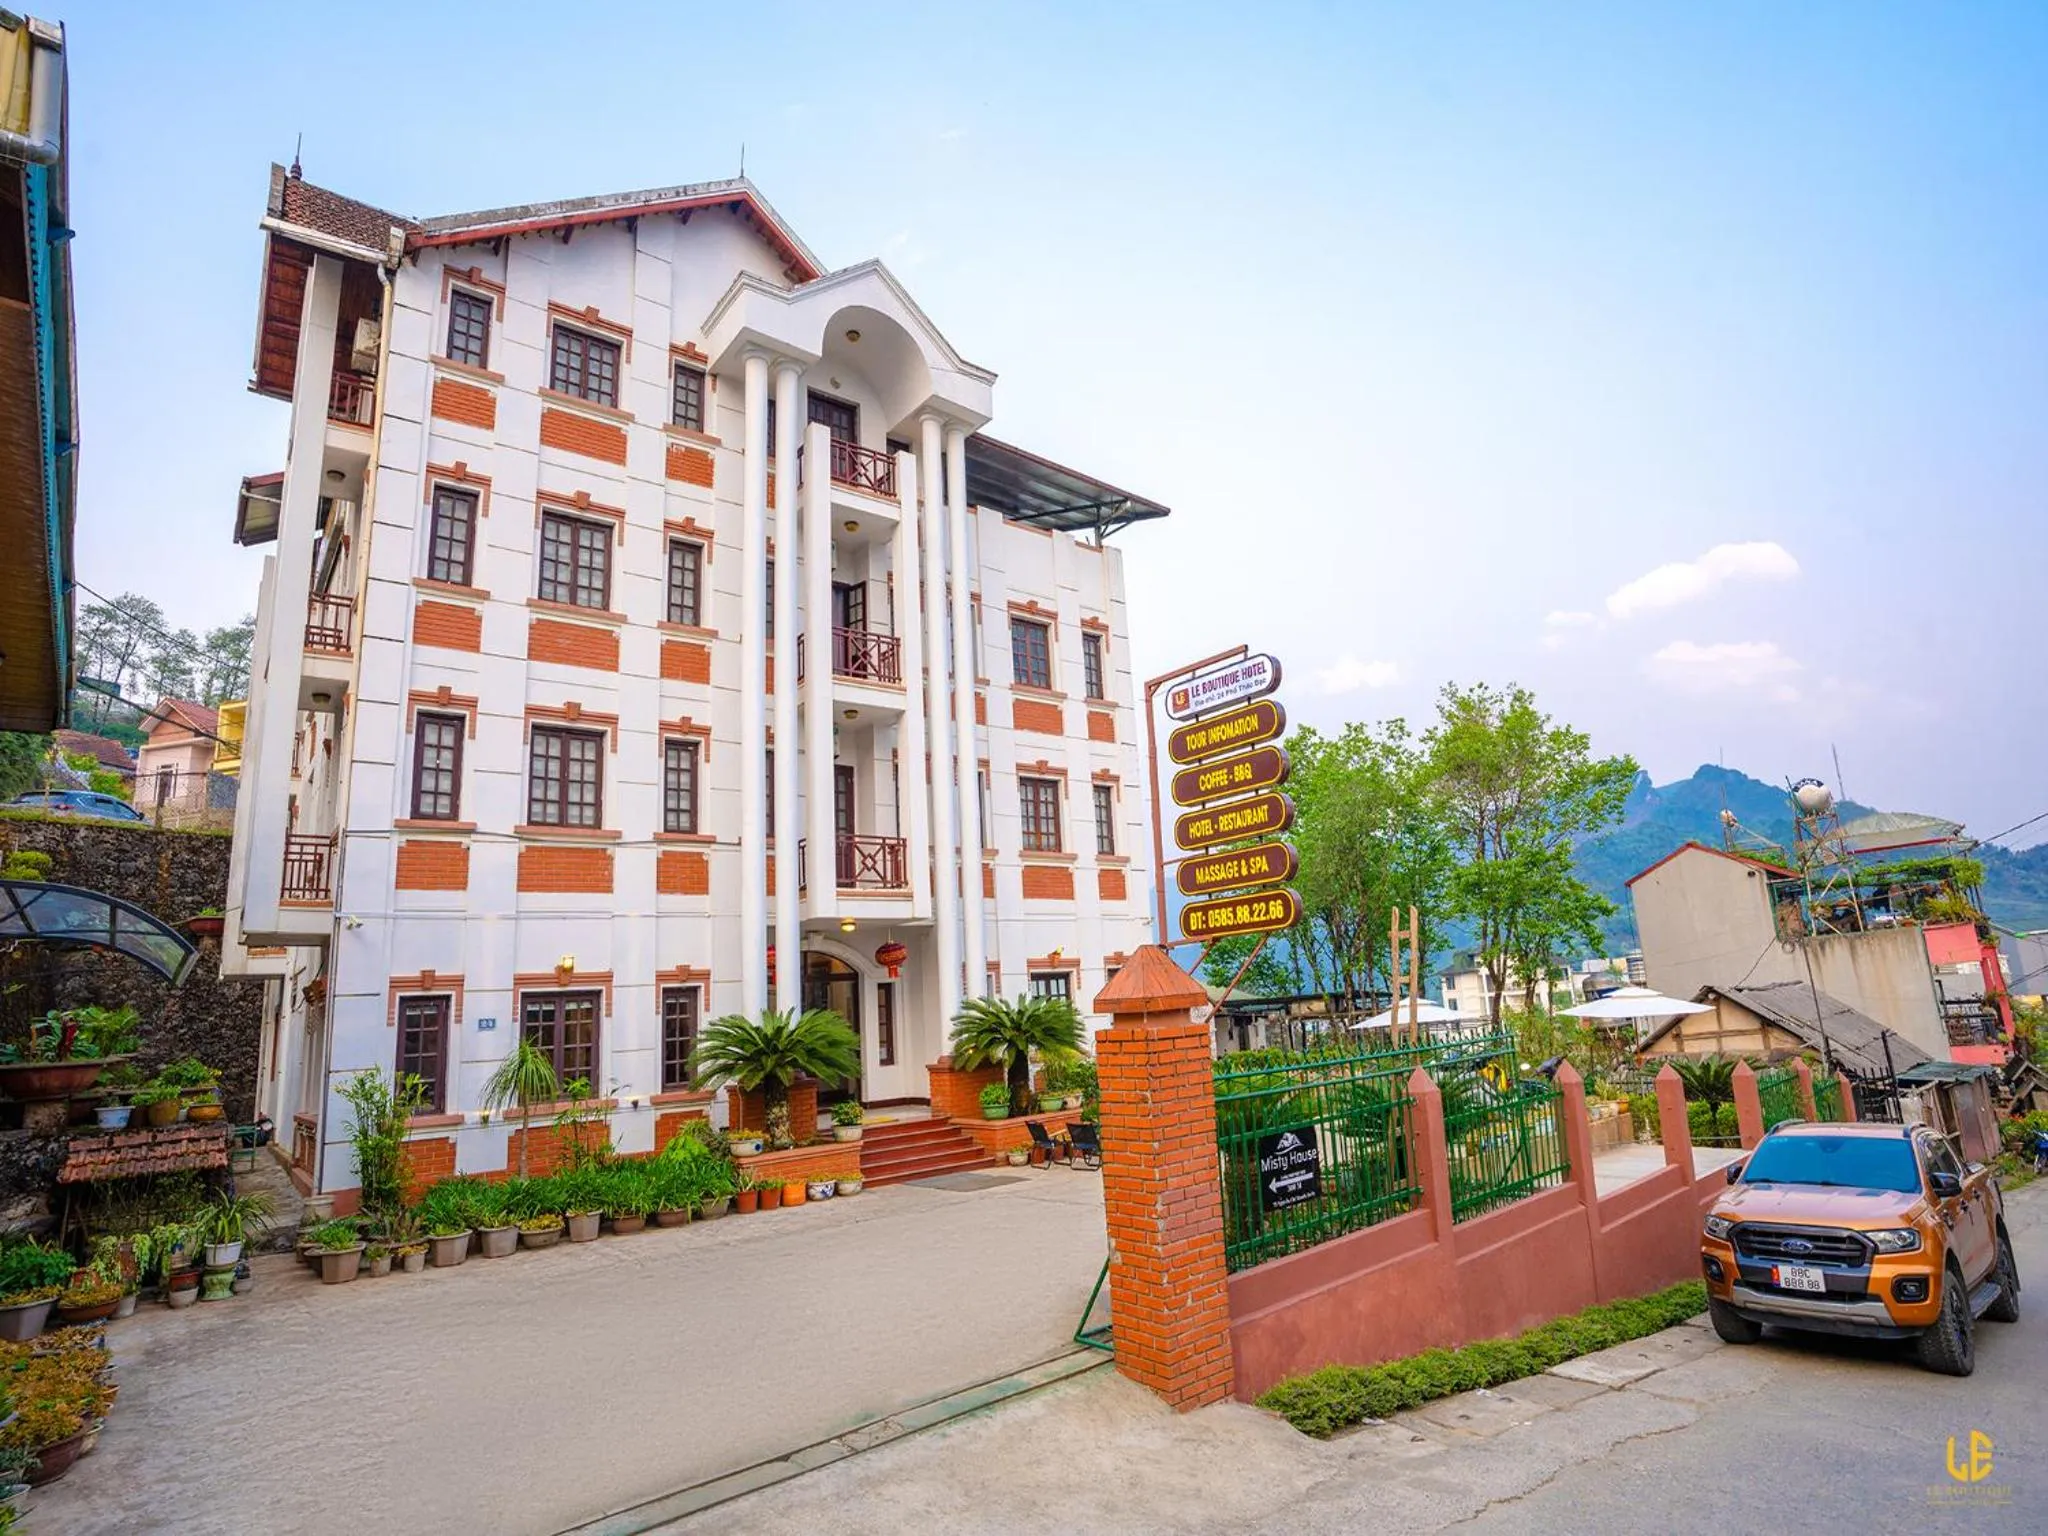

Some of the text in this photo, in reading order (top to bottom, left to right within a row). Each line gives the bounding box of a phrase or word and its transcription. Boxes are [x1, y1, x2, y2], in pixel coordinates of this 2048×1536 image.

[1191, 661, 1267, 698] LE BOUTIQUE HOTEL
[1186, 714, 1259, 751] TOUR INFOMATION
[1199, 768, 1228, 792] COFFEE
[1234, 762, 1253, 783] BBQ
[1188, 819, 1213, 839] HOTEL
[1218, 805, 1269, 832] RESTAURANT
[1195, 855, 1270, 884] MASSAGE & SPA
[1208, 900, 1284, 928] 0585.88.22.66
[1261, 1148, 1317, 1172] Misty House
